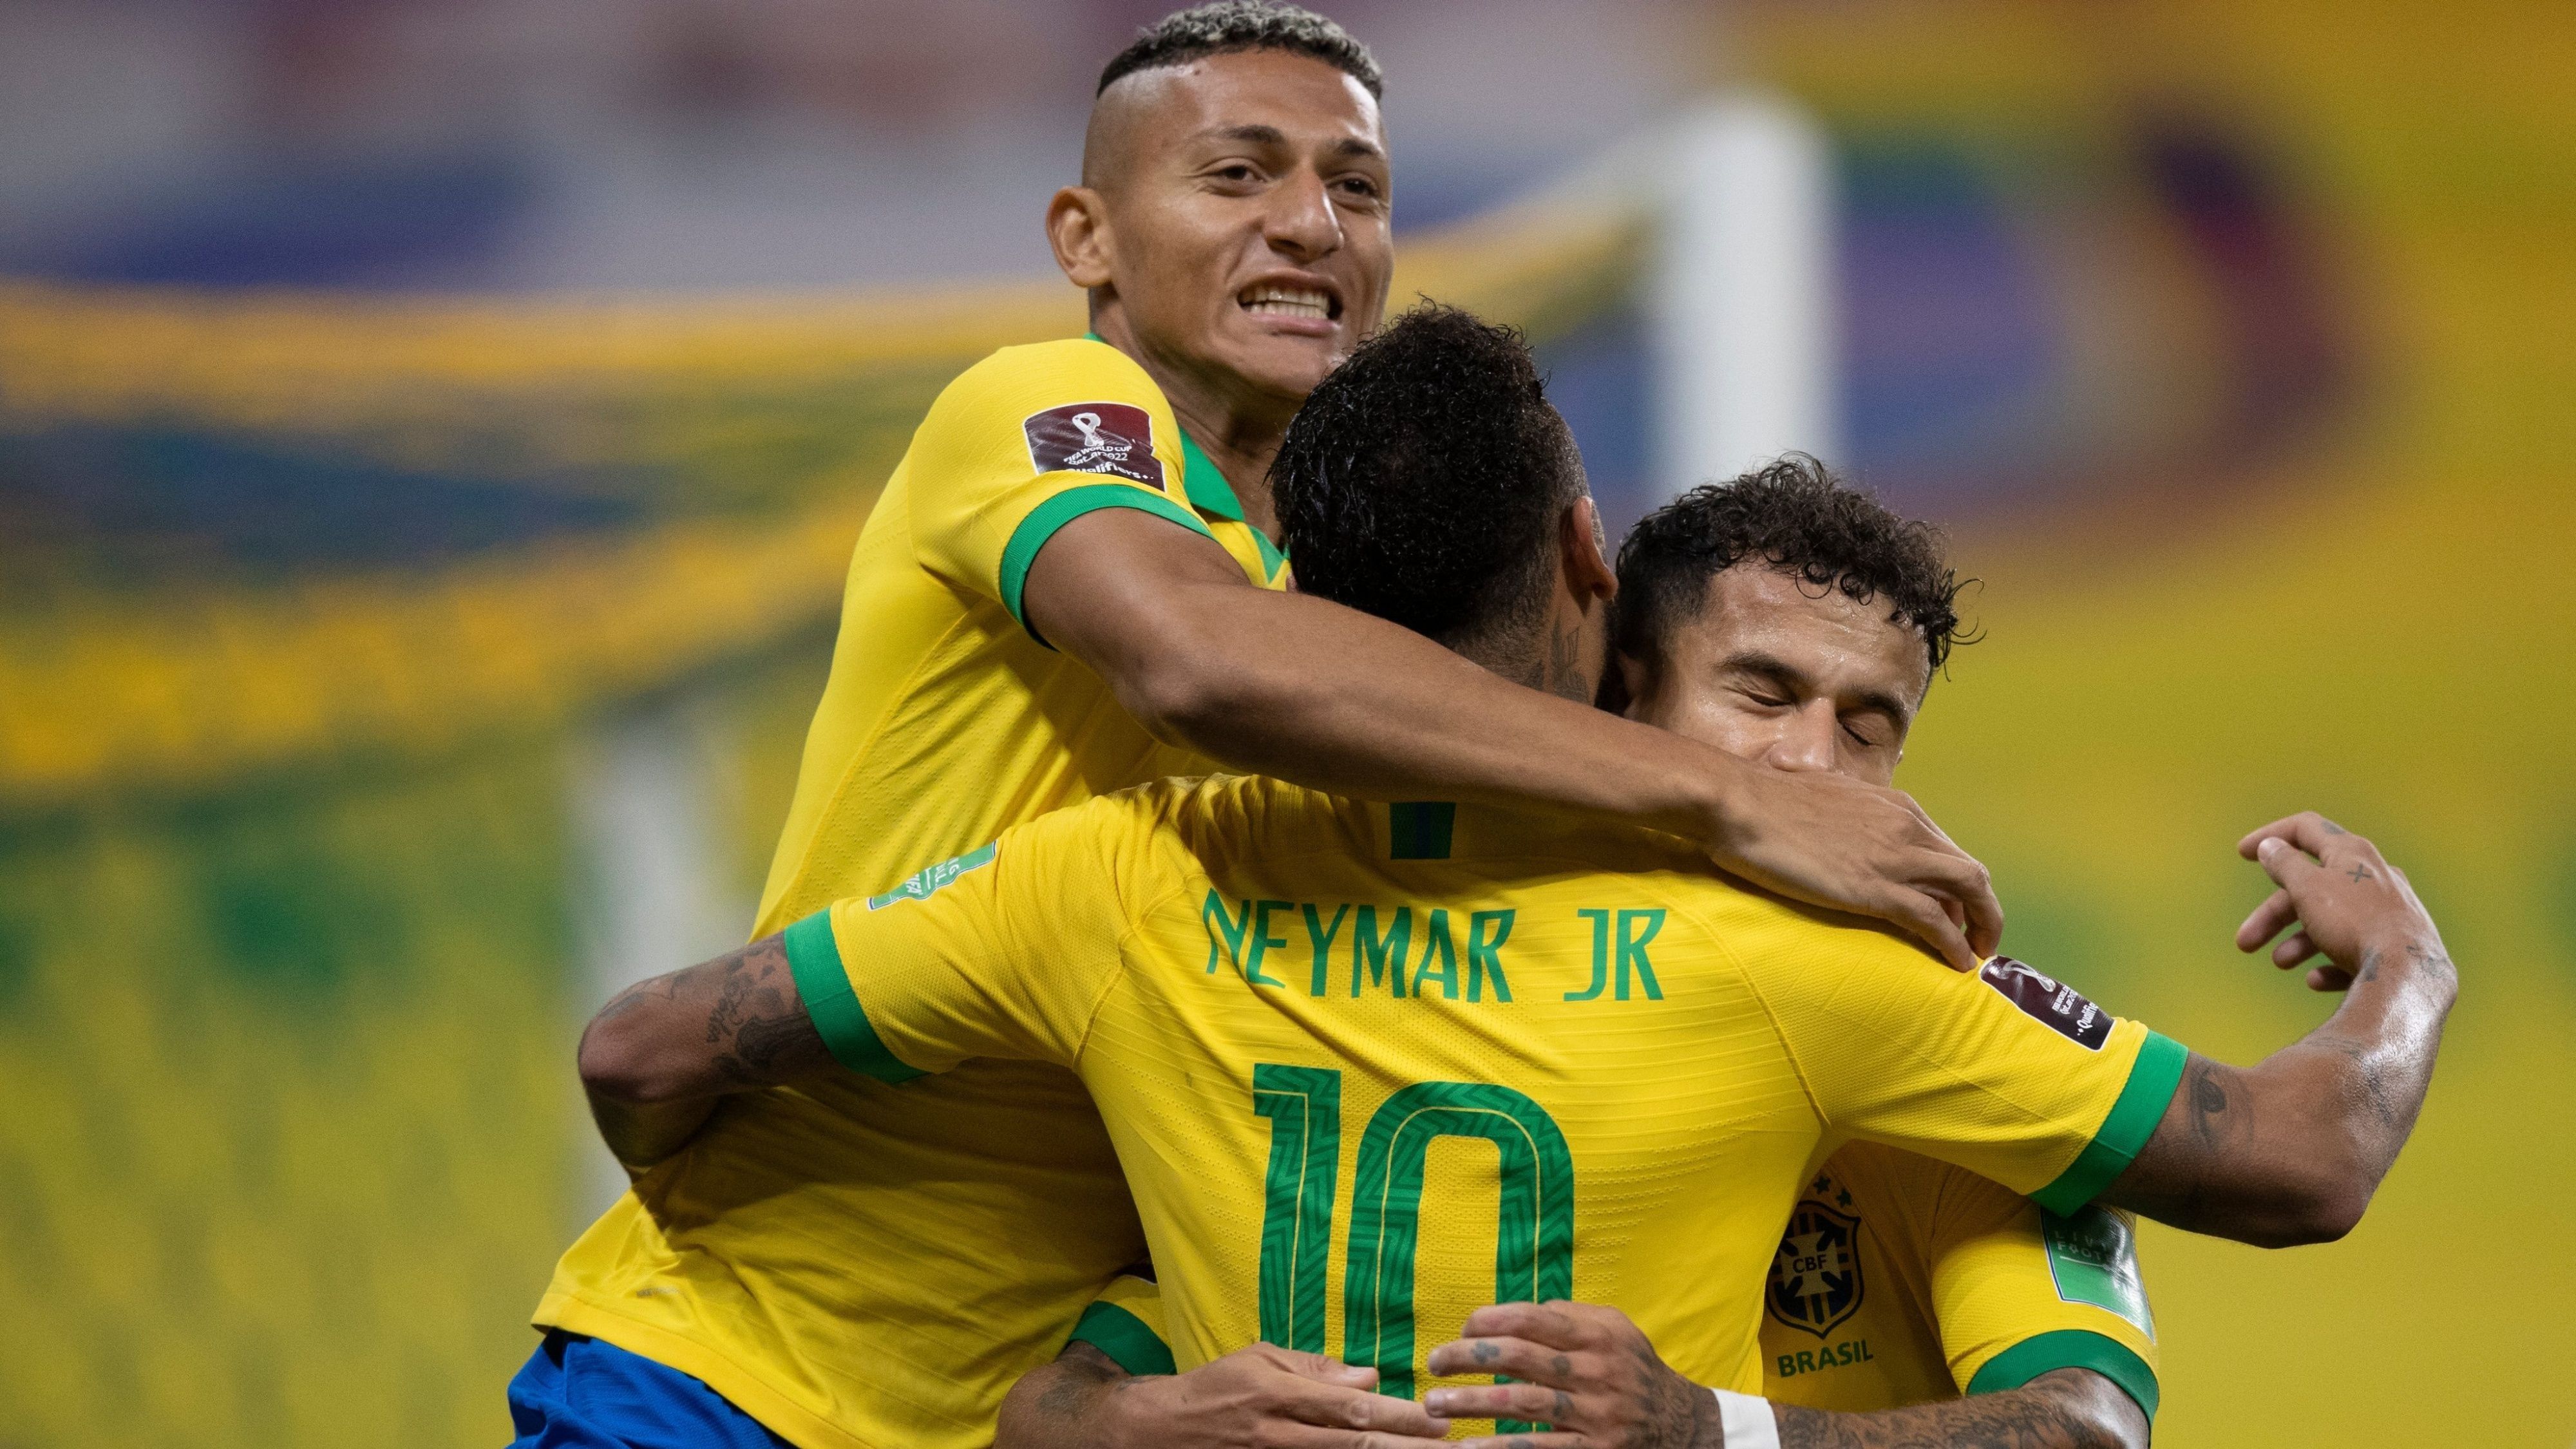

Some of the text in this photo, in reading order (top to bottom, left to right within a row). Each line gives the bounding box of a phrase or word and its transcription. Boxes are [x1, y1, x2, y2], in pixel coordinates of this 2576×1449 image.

[1081, 446, 1113, 455] WORLD
[1203, 887, 1667, 1003] NEYMAR JR
[1253, 1063, 1575, 1436] 10
[1792, 1254, 1827, 1274] CBF
[1777, 1339, 1873, 1378] BRASIL
